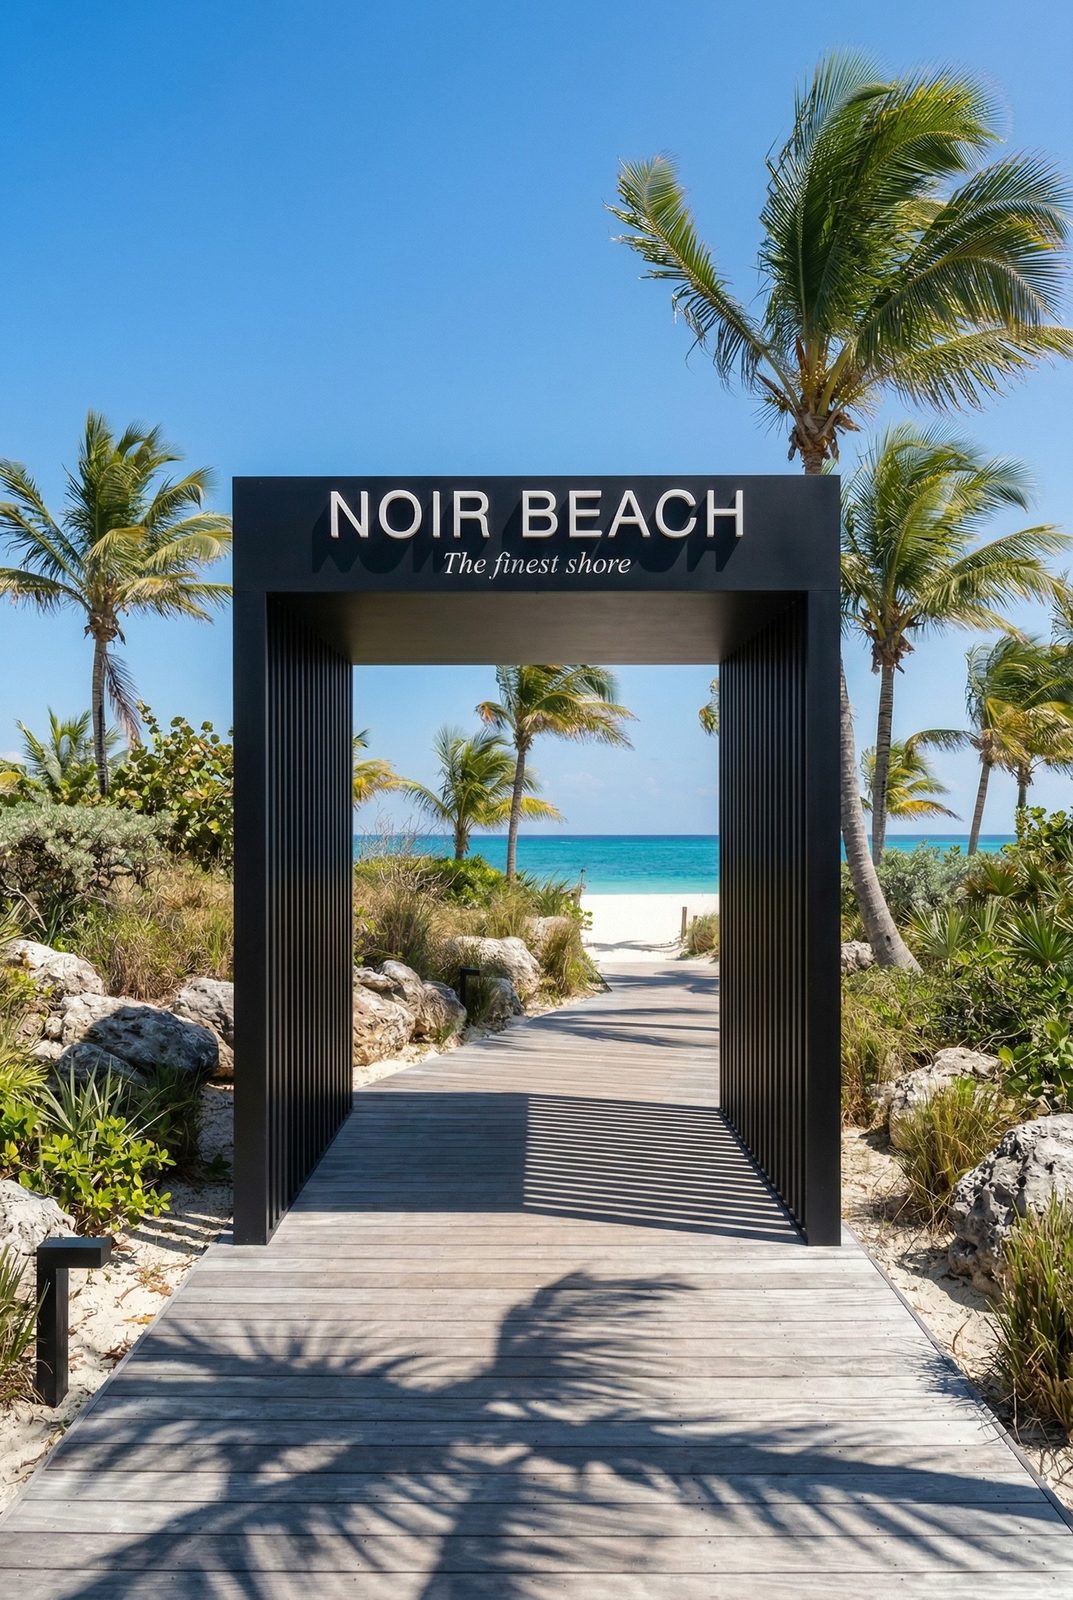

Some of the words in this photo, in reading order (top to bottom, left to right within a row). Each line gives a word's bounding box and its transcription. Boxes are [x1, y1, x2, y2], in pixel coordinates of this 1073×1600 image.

[330, 489, 490, 539] NOIR
[521, 489, 744, 539] BEACH
[443, 552, 487, 575] The
[488, 552, 560, 580] finest
[565, 552, 632, 575] shore
